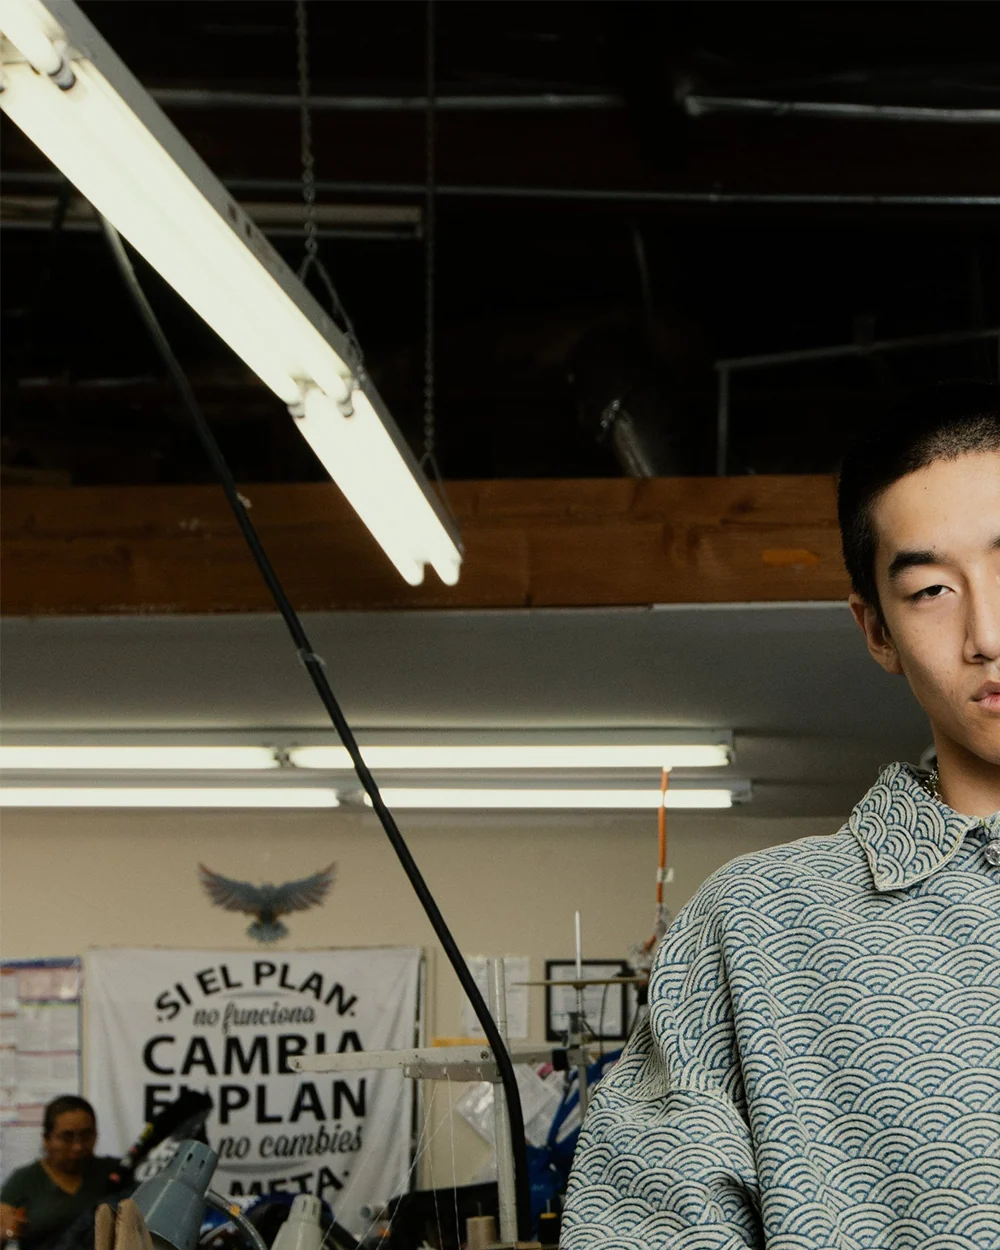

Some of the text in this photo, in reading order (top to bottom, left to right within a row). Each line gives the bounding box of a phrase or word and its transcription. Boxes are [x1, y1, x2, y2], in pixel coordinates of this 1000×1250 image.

[195, 963, 242, 996] EL
[193, 1001, 316, 1034] no funciona
[218, 1078, 367, 1125] PLAN
[218, 1124, 363, 1158] no cambies
